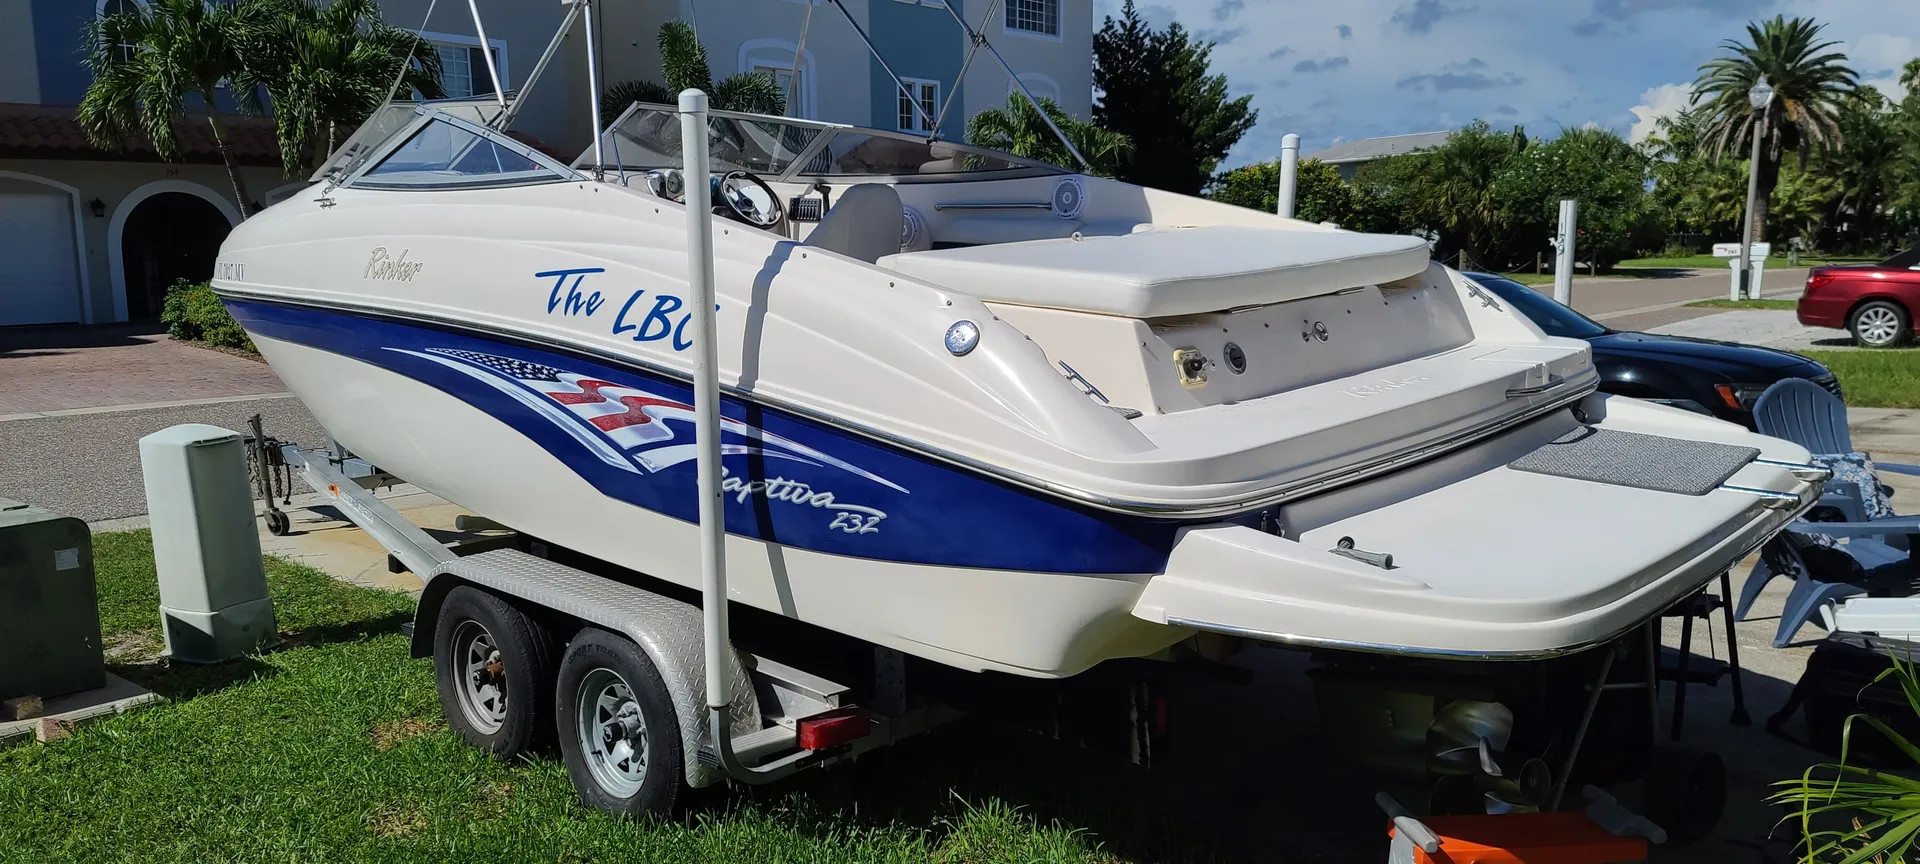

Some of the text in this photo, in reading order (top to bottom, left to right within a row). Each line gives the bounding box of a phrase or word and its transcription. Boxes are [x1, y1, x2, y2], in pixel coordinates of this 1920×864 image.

[364, 246, 424, 282] Rinker
[534, 267, 606, 317] The
[697, 465, 888, 520] aptiva
[828, 511, 882, 535] 232
